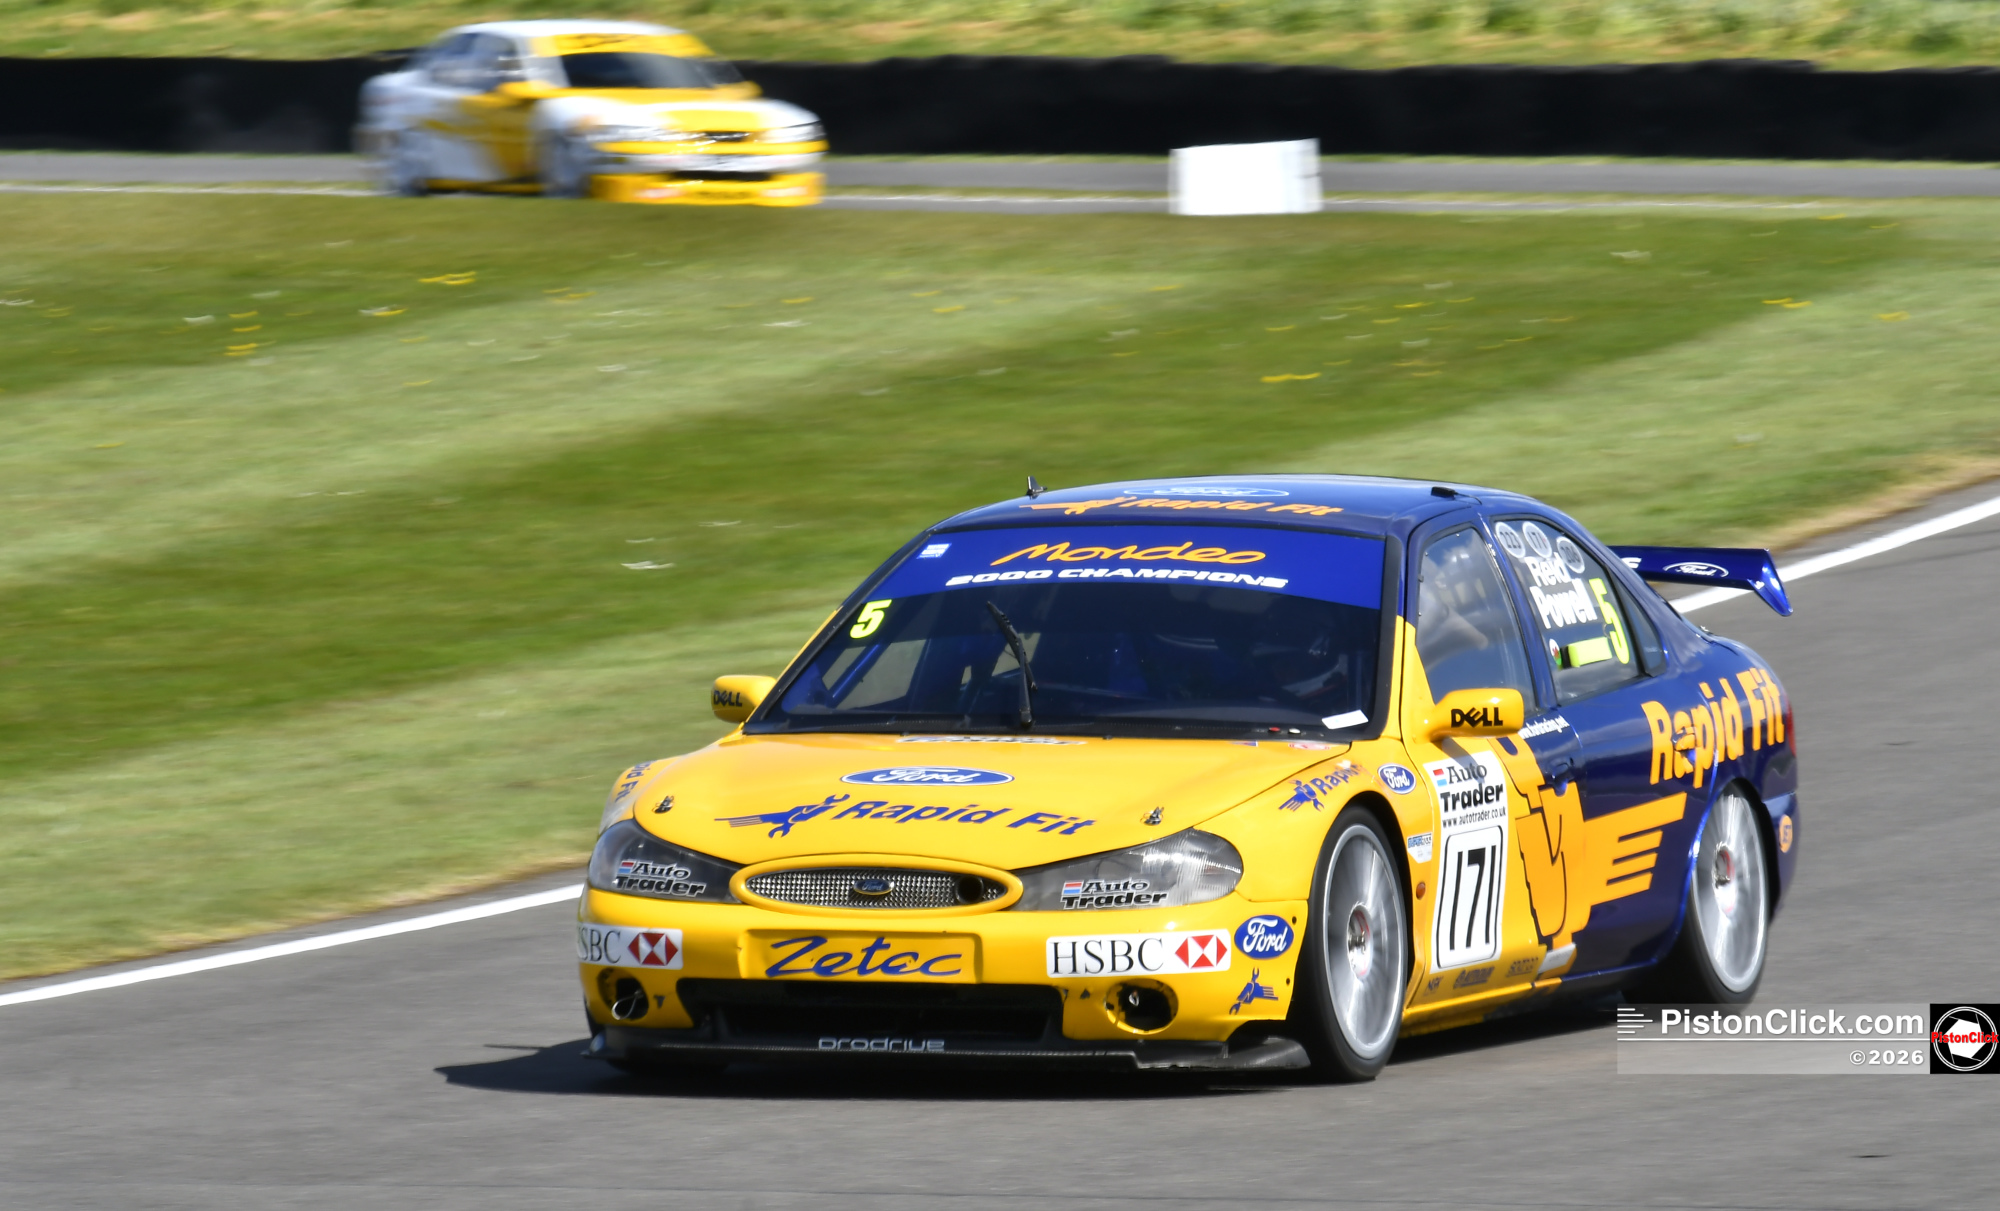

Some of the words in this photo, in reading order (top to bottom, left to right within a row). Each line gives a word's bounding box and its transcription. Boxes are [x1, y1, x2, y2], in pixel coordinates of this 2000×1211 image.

[1119, 498, 1275, 511] Rapid
[991, 541, 1266, 565] Mondeo
[946, 569, 1053, 586] 2000
[1058, 568, 1289, 589] CHAMPIONS
[1524, 552, 1571, 587] Reid
[1529, 578, 1597, 629] Powell
[850, 599, 892, 638] 5
[1589, 578, 1629, 664] 5
[713, 690, 742, 707] DELL
[1450, 707, 1503, 728] DELL
[1641, 677, 1744, 789] Rapid
[1737, 667, 1785, 751] Fit
[874, 768, 981, 783] Ford
[1383, 767, 1410, 790] Ford
[1446, 763, 1488, 785] Auto
[1440, 783, 1504, 813] Trader
[832, 800, 1013, 824] Rapid
[1006, 811, 1097, 835] Fit
[1442, 806, 1507, 828] www.autotrader.co.uk
[631, 861, 691, 879] Auto
[615, 876, 706, 897] Trader
[1082, 879, 1150, 893] Auto
[1449, 845, 1497, 951] 171
[1061, 891, 1168, 910] Trader
[577, 926, 622, 964] SBC
[1243, 917, 1288, 953] Ford
[764, 935, 963, 979] Zetec
[1049, 937, 1165, 975] HSBC
